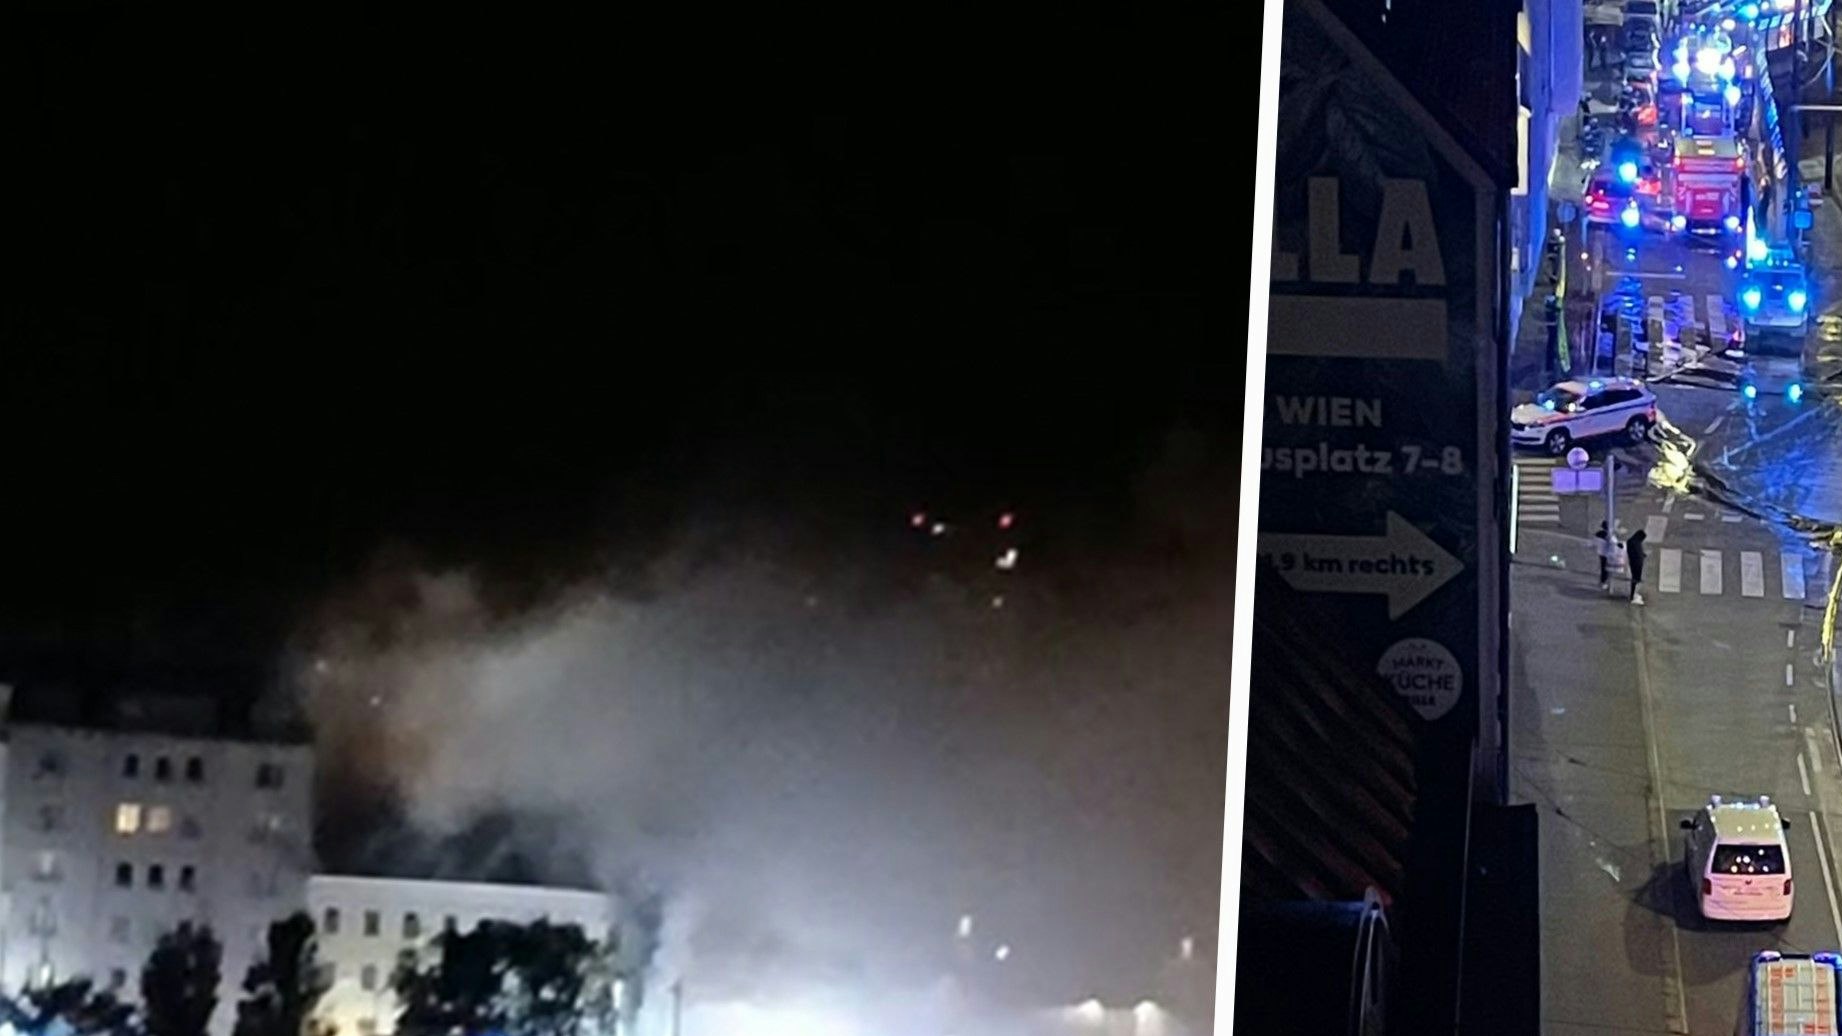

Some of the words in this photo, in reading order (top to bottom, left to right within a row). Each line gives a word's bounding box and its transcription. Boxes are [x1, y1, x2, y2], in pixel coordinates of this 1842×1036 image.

[1275, 394, 1383, 428] WIEN
[1303, 551, 1343, 573] km
[1348, 552, 1435, 575] rechts
[1391, 655, 1445, 669] MARKT
